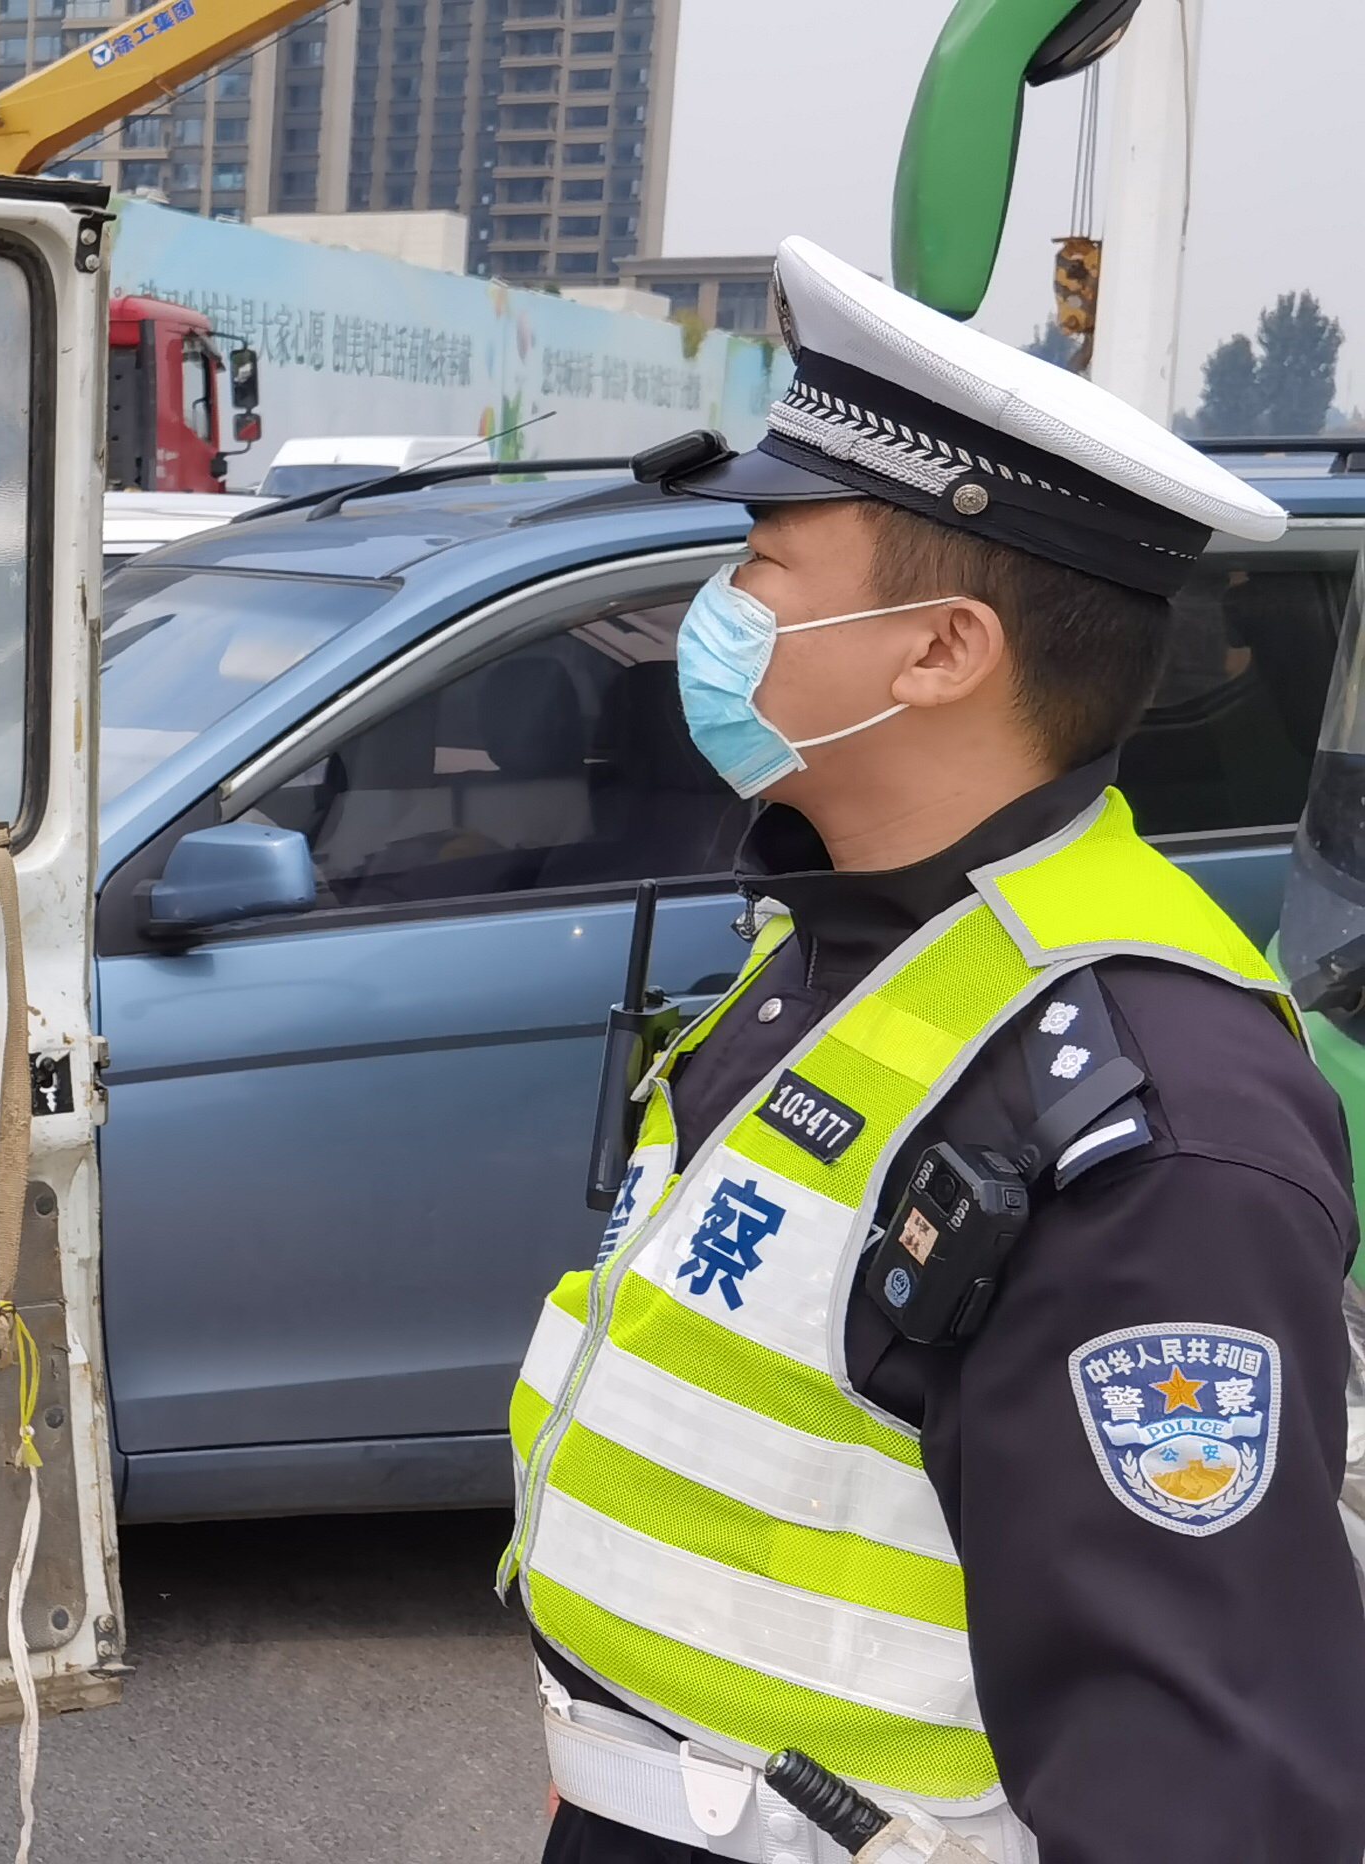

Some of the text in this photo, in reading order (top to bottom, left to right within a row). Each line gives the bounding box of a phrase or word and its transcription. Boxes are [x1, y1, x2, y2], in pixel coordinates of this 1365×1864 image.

[112, 0, 195, 57] 徐工集团
[768, 1084, 854, 1150] 103477
[676, 1178, 788, 1312] 察
[1084, 1338, 1263, 1384] 中华人民共和国
[1146, 1419, 1225, 1441] POLICE
